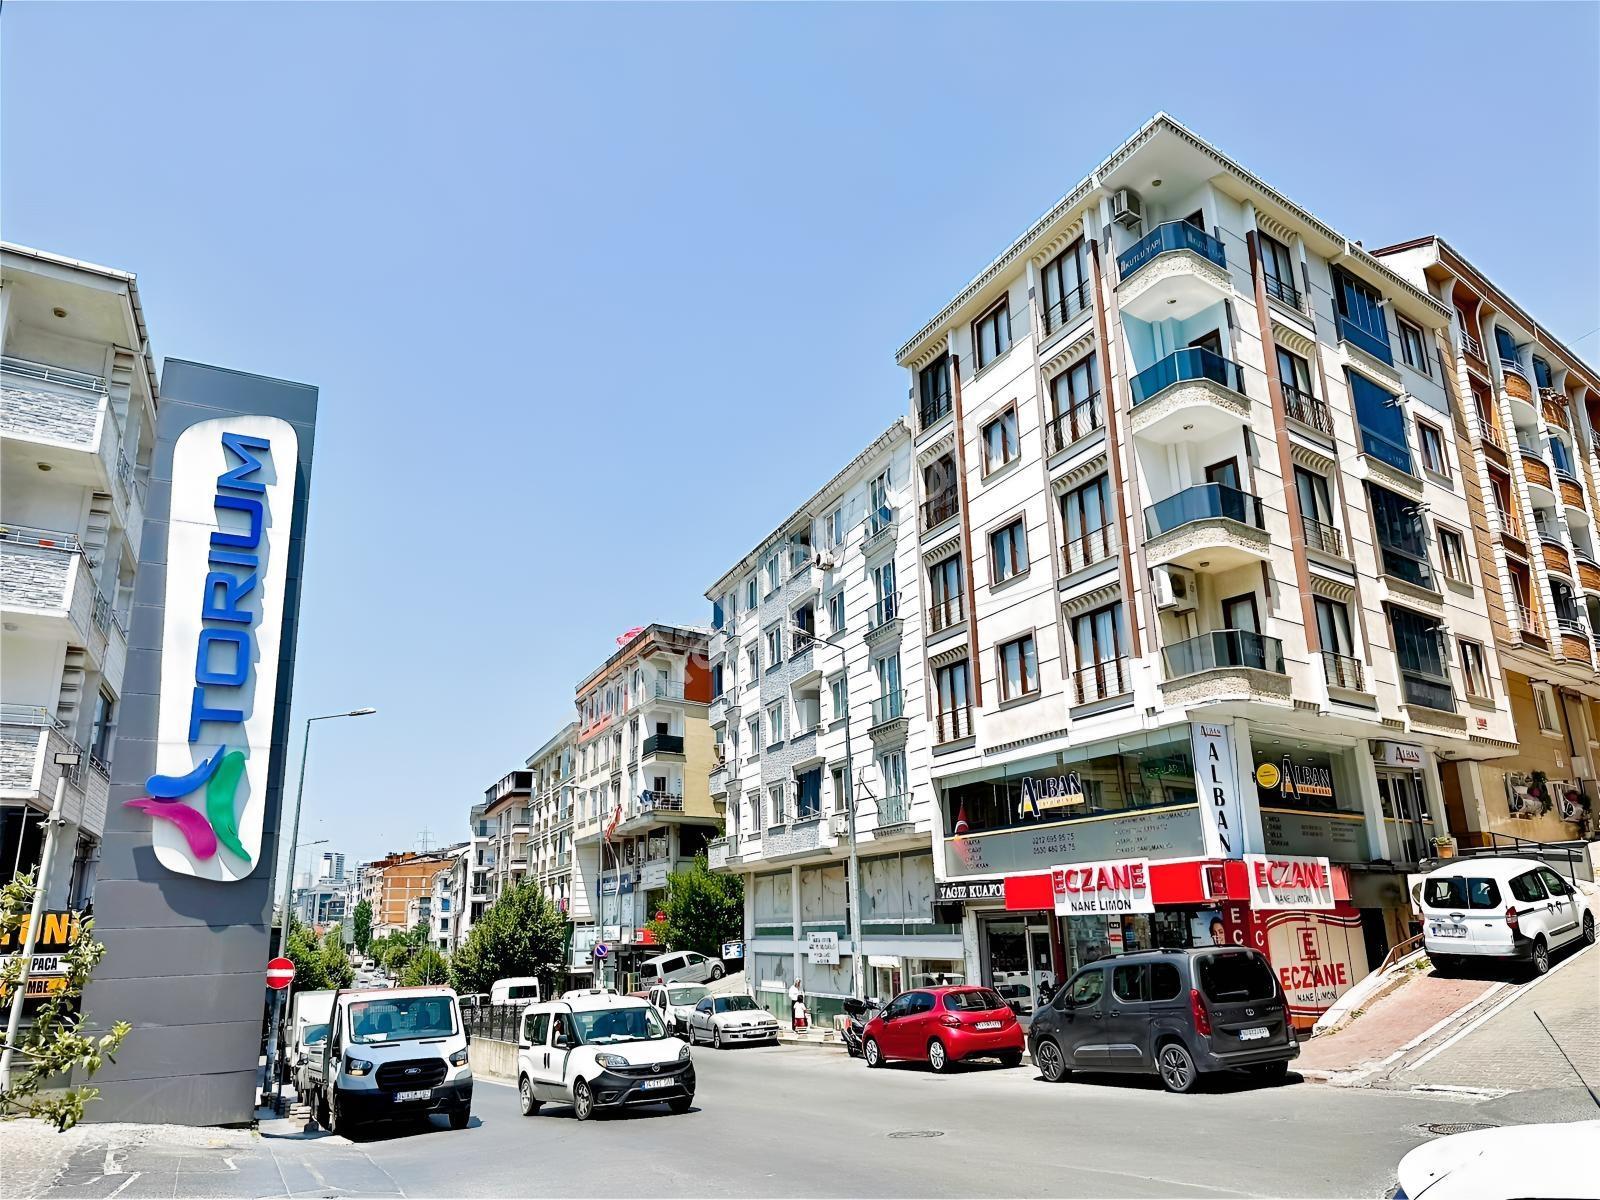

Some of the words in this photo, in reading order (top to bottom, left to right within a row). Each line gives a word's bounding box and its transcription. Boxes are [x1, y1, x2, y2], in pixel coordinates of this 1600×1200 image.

[1125, 250, 1146, 270] KUTLU
[187, 431, 271, 743] TORIUM
[1395, 746, 1420, 763] ALBAN
[1281, 758, 1331, 800] ALBAN
[1019, 771, 1082, 819] ALBAN
[1208, 742, 1232, 853] ALBAN
[1052, 862, 1146, 894] ECZANE
[1254, 860, 1330, 889] ECZANE
[1071, 900, 1096, 912] NANE
[1279, 962, 1347, 991] ECZANE
[1297, 992, 1315, 1002] NANE
